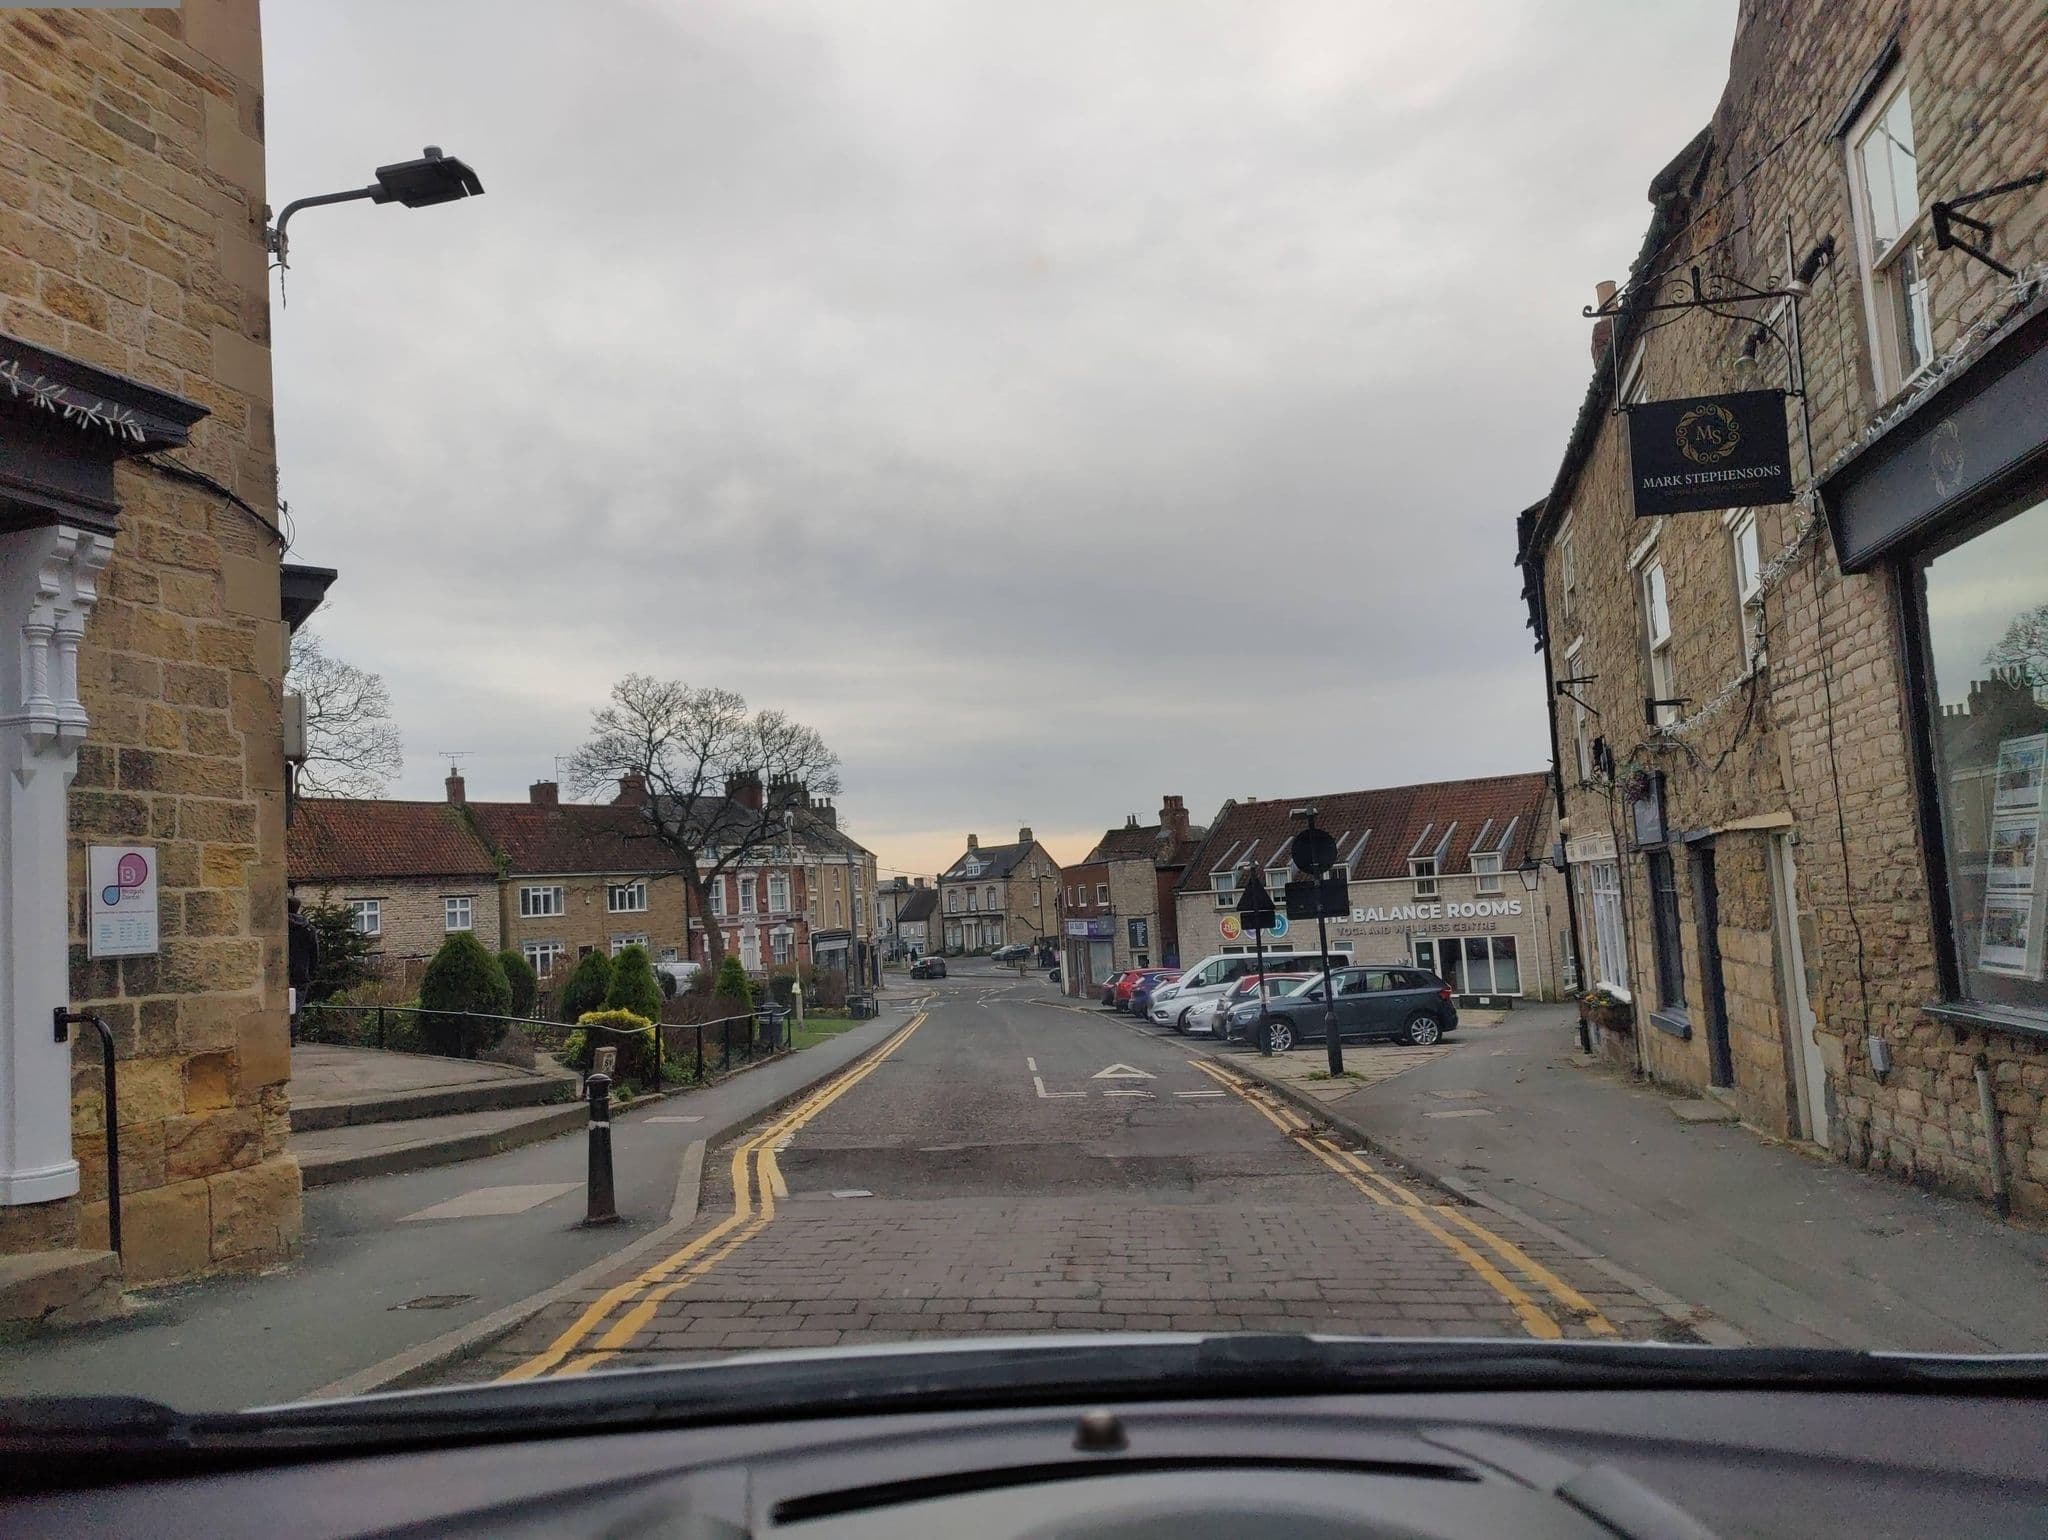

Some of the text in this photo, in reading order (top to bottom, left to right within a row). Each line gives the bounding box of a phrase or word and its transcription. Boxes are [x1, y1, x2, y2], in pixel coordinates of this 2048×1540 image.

[1696, 425, 1722, 445] MS
[1643, 475, 1683, 489] MARK
[1685, 465, 1781, 485] STEPHENSONS
[1352, 904, 1442, 923] BALANCE
[1447, 900, 1522, 919] ROOMS
[1368, 926, 1392, 936] AND
[1453, 921, 1497, 932] CENTRE
